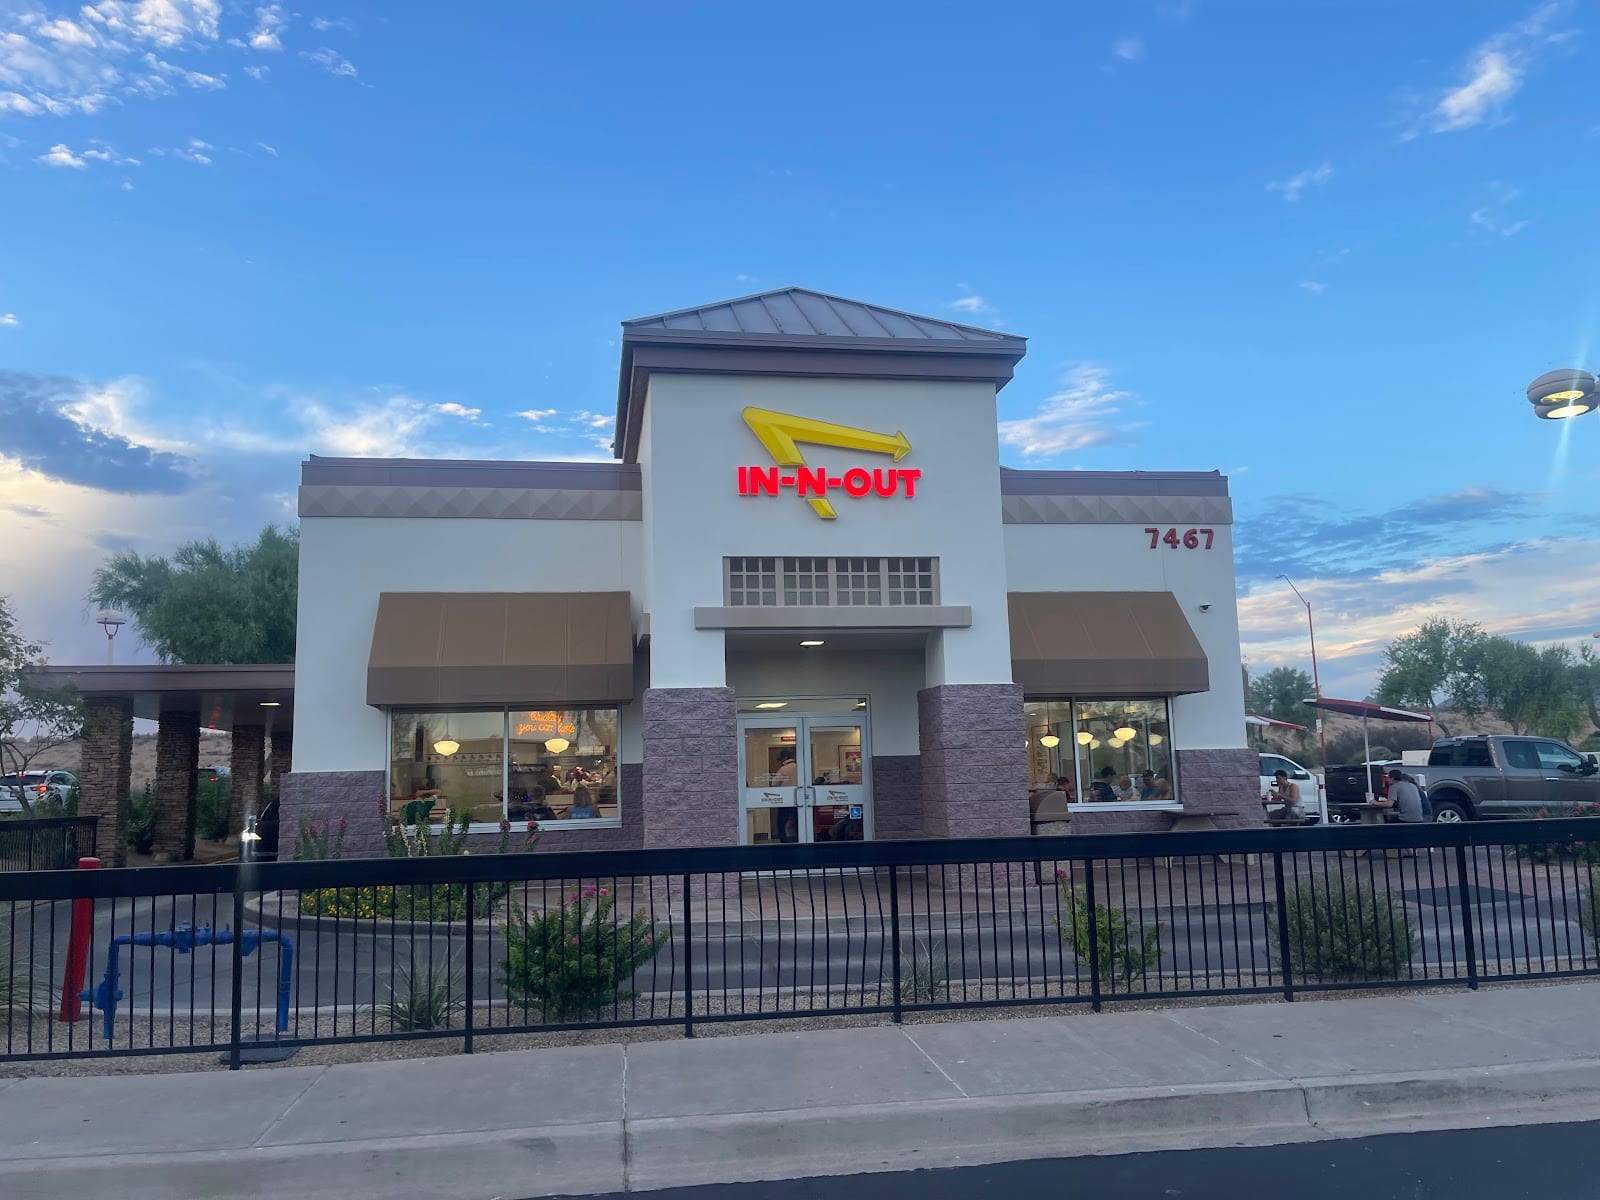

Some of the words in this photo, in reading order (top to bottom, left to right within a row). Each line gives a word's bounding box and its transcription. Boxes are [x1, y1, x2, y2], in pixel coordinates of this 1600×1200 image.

[738, 466, 922, 498] IN-N-OUT
[1144, 527, 1215, 549] 7467
[529, 711, 562, 724] Quality
[517, 723, 536, 735] you
[538, 724, 554, 732] can
[557, 722, 576, 733] taste
